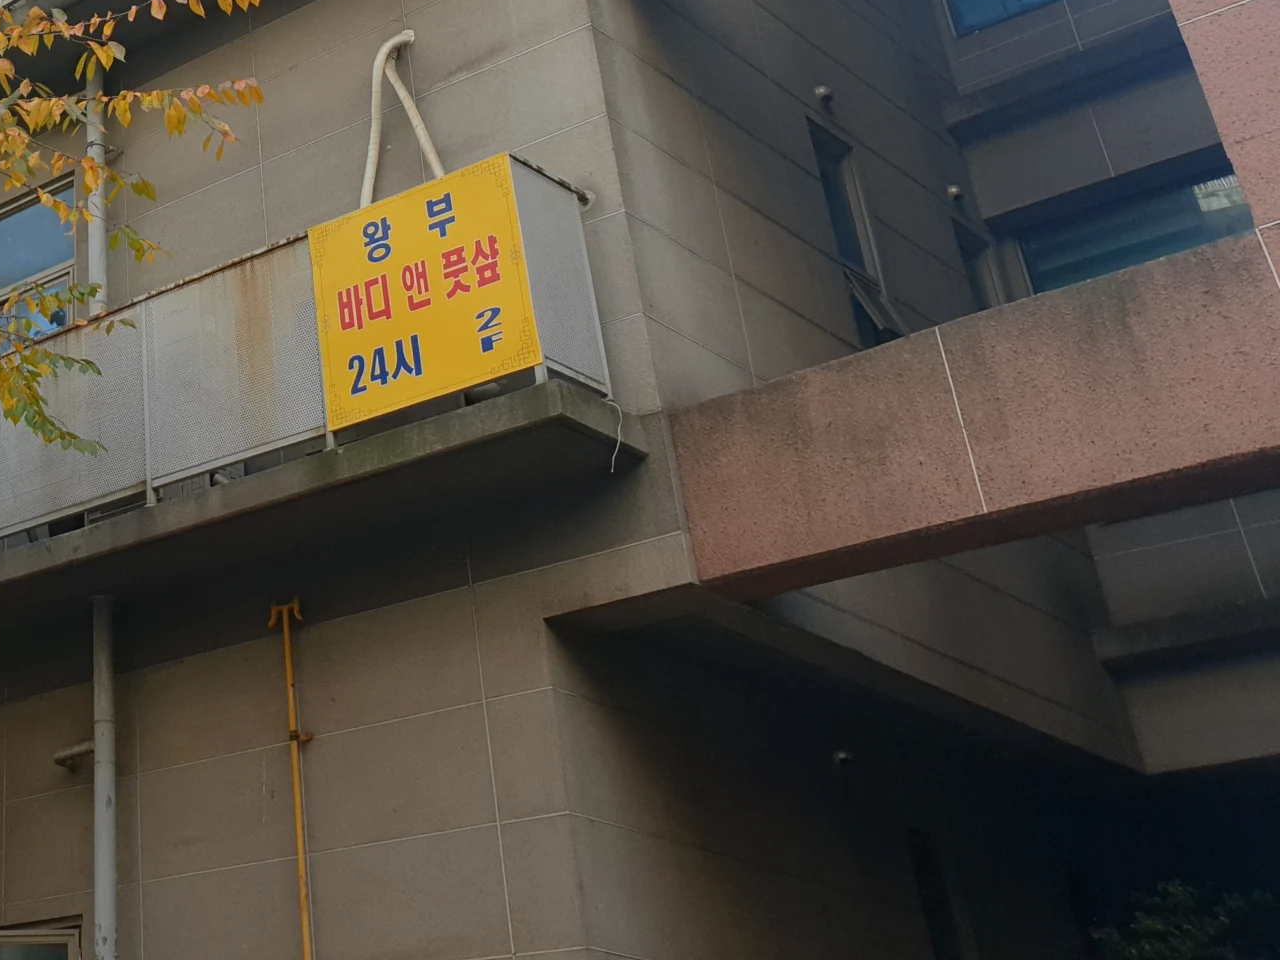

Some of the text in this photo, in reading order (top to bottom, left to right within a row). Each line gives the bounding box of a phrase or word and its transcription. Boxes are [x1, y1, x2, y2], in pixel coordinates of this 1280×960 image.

[337, 273, 392, 331] 바디
[401, 259, 432, 312] 앤
[348, 334, 423, 396] 24시
